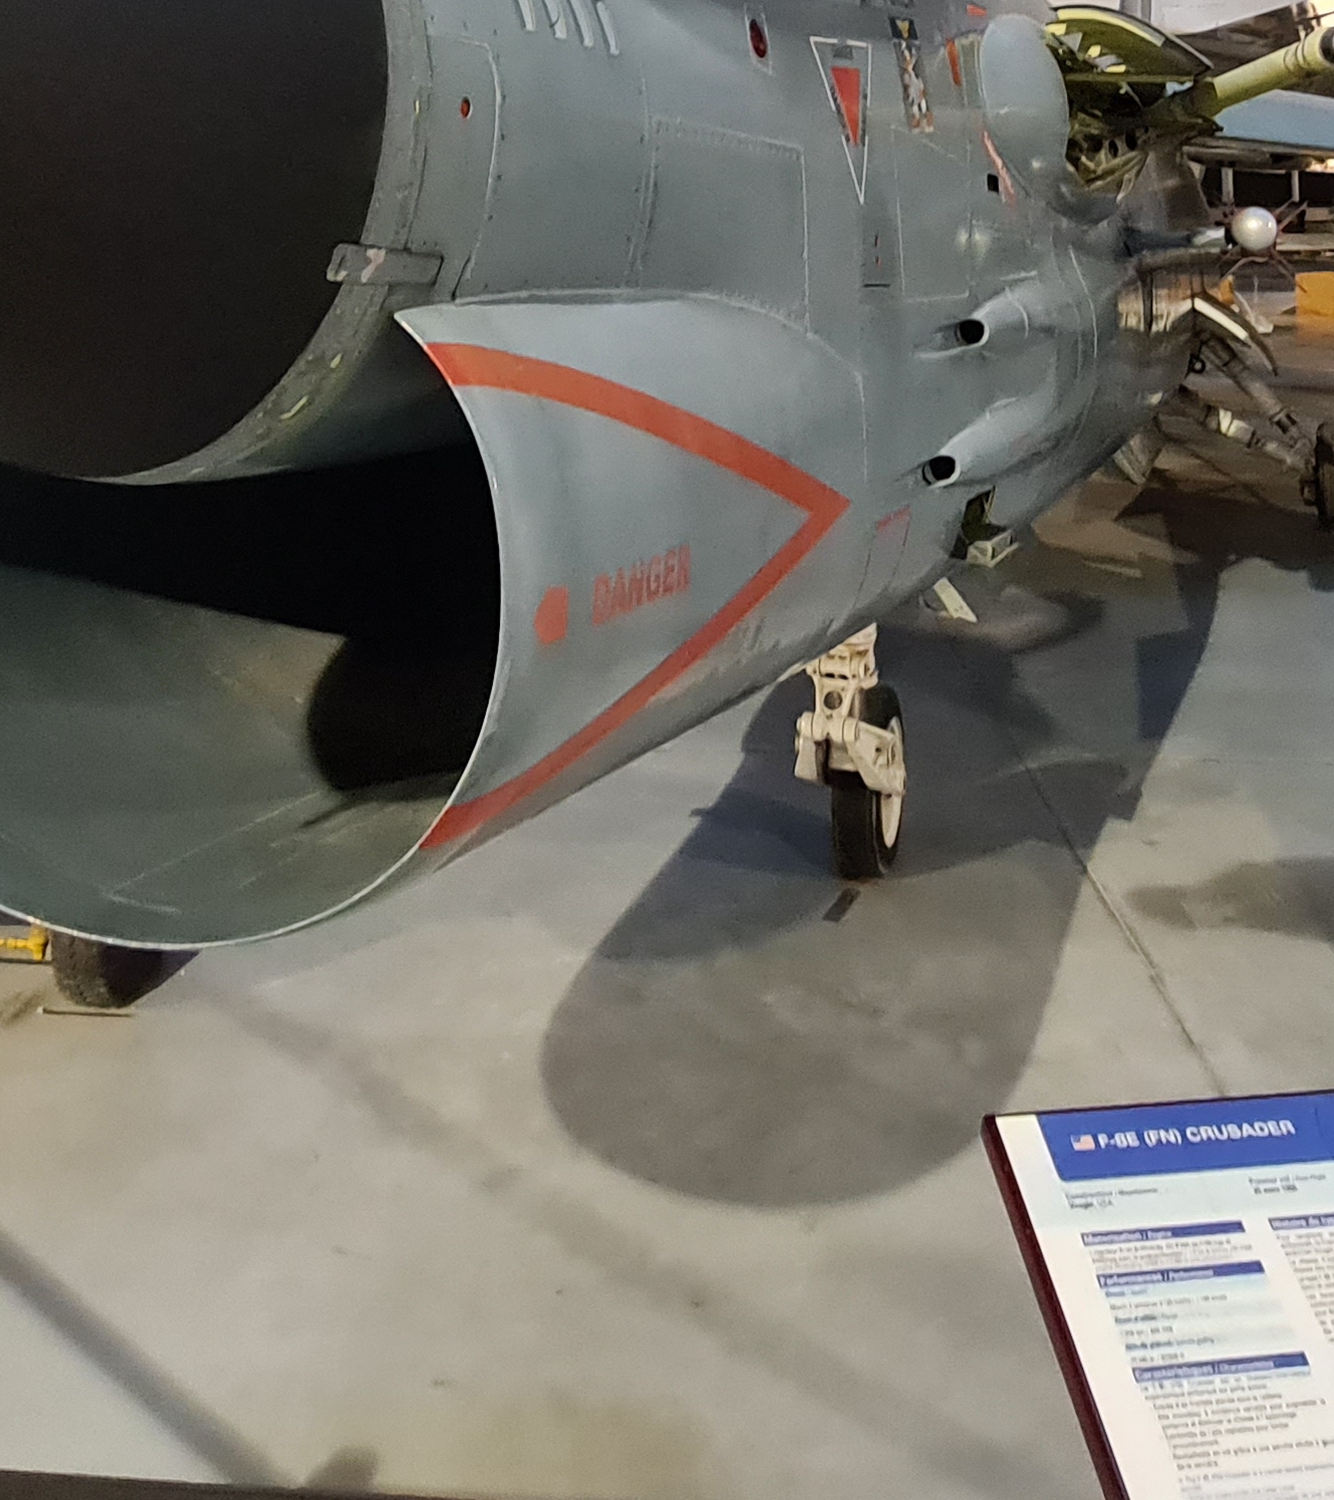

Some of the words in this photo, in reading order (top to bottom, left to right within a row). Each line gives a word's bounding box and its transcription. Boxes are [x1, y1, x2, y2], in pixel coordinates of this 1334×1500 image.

[591, 542, 691, 627] DANGER
[1143, 1127, 1183, 1148] (FN)
[1185, 1119, 1296, 1143] CRUSADER
